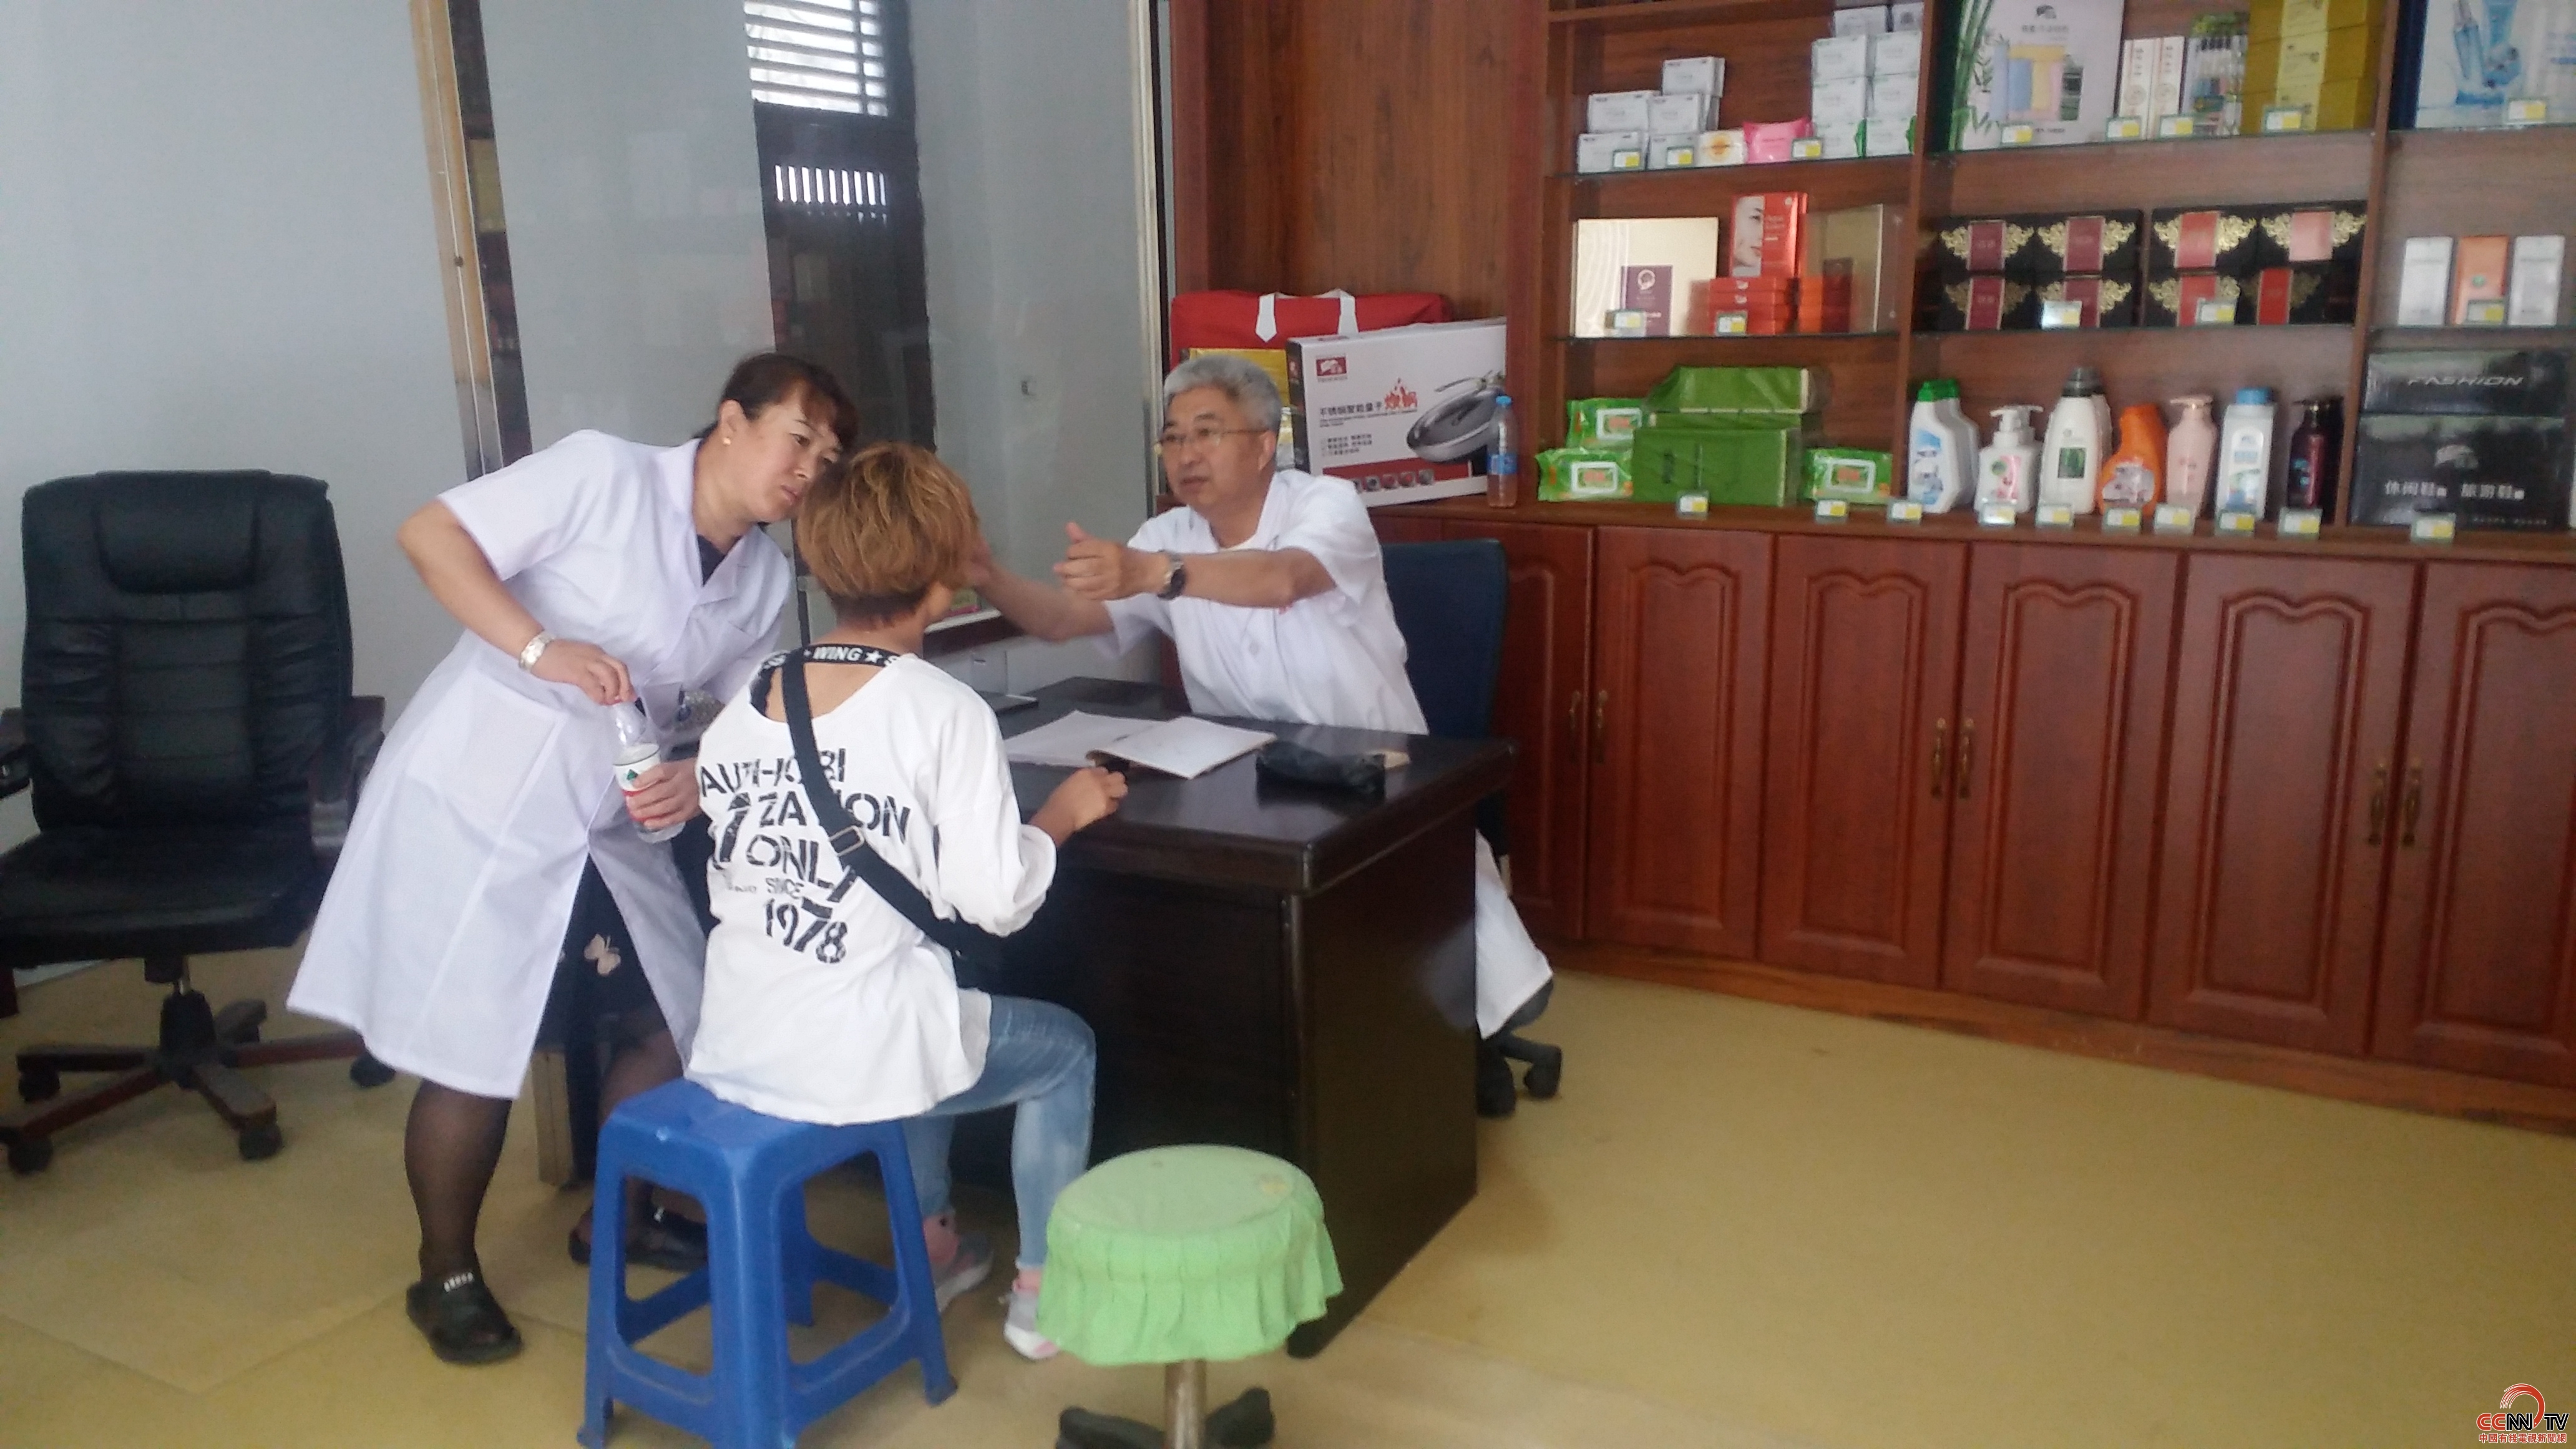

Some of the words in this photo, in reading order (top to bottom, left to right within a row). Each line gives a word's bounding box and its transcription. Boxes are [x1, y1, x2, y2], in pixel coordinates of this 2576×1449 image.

[2408, 376, 2524, 386] FASHION
[812, 646, 864, 661] WING
[758, 789, 911, 846] ZAON
[766, 897, 848, 964] 1978
